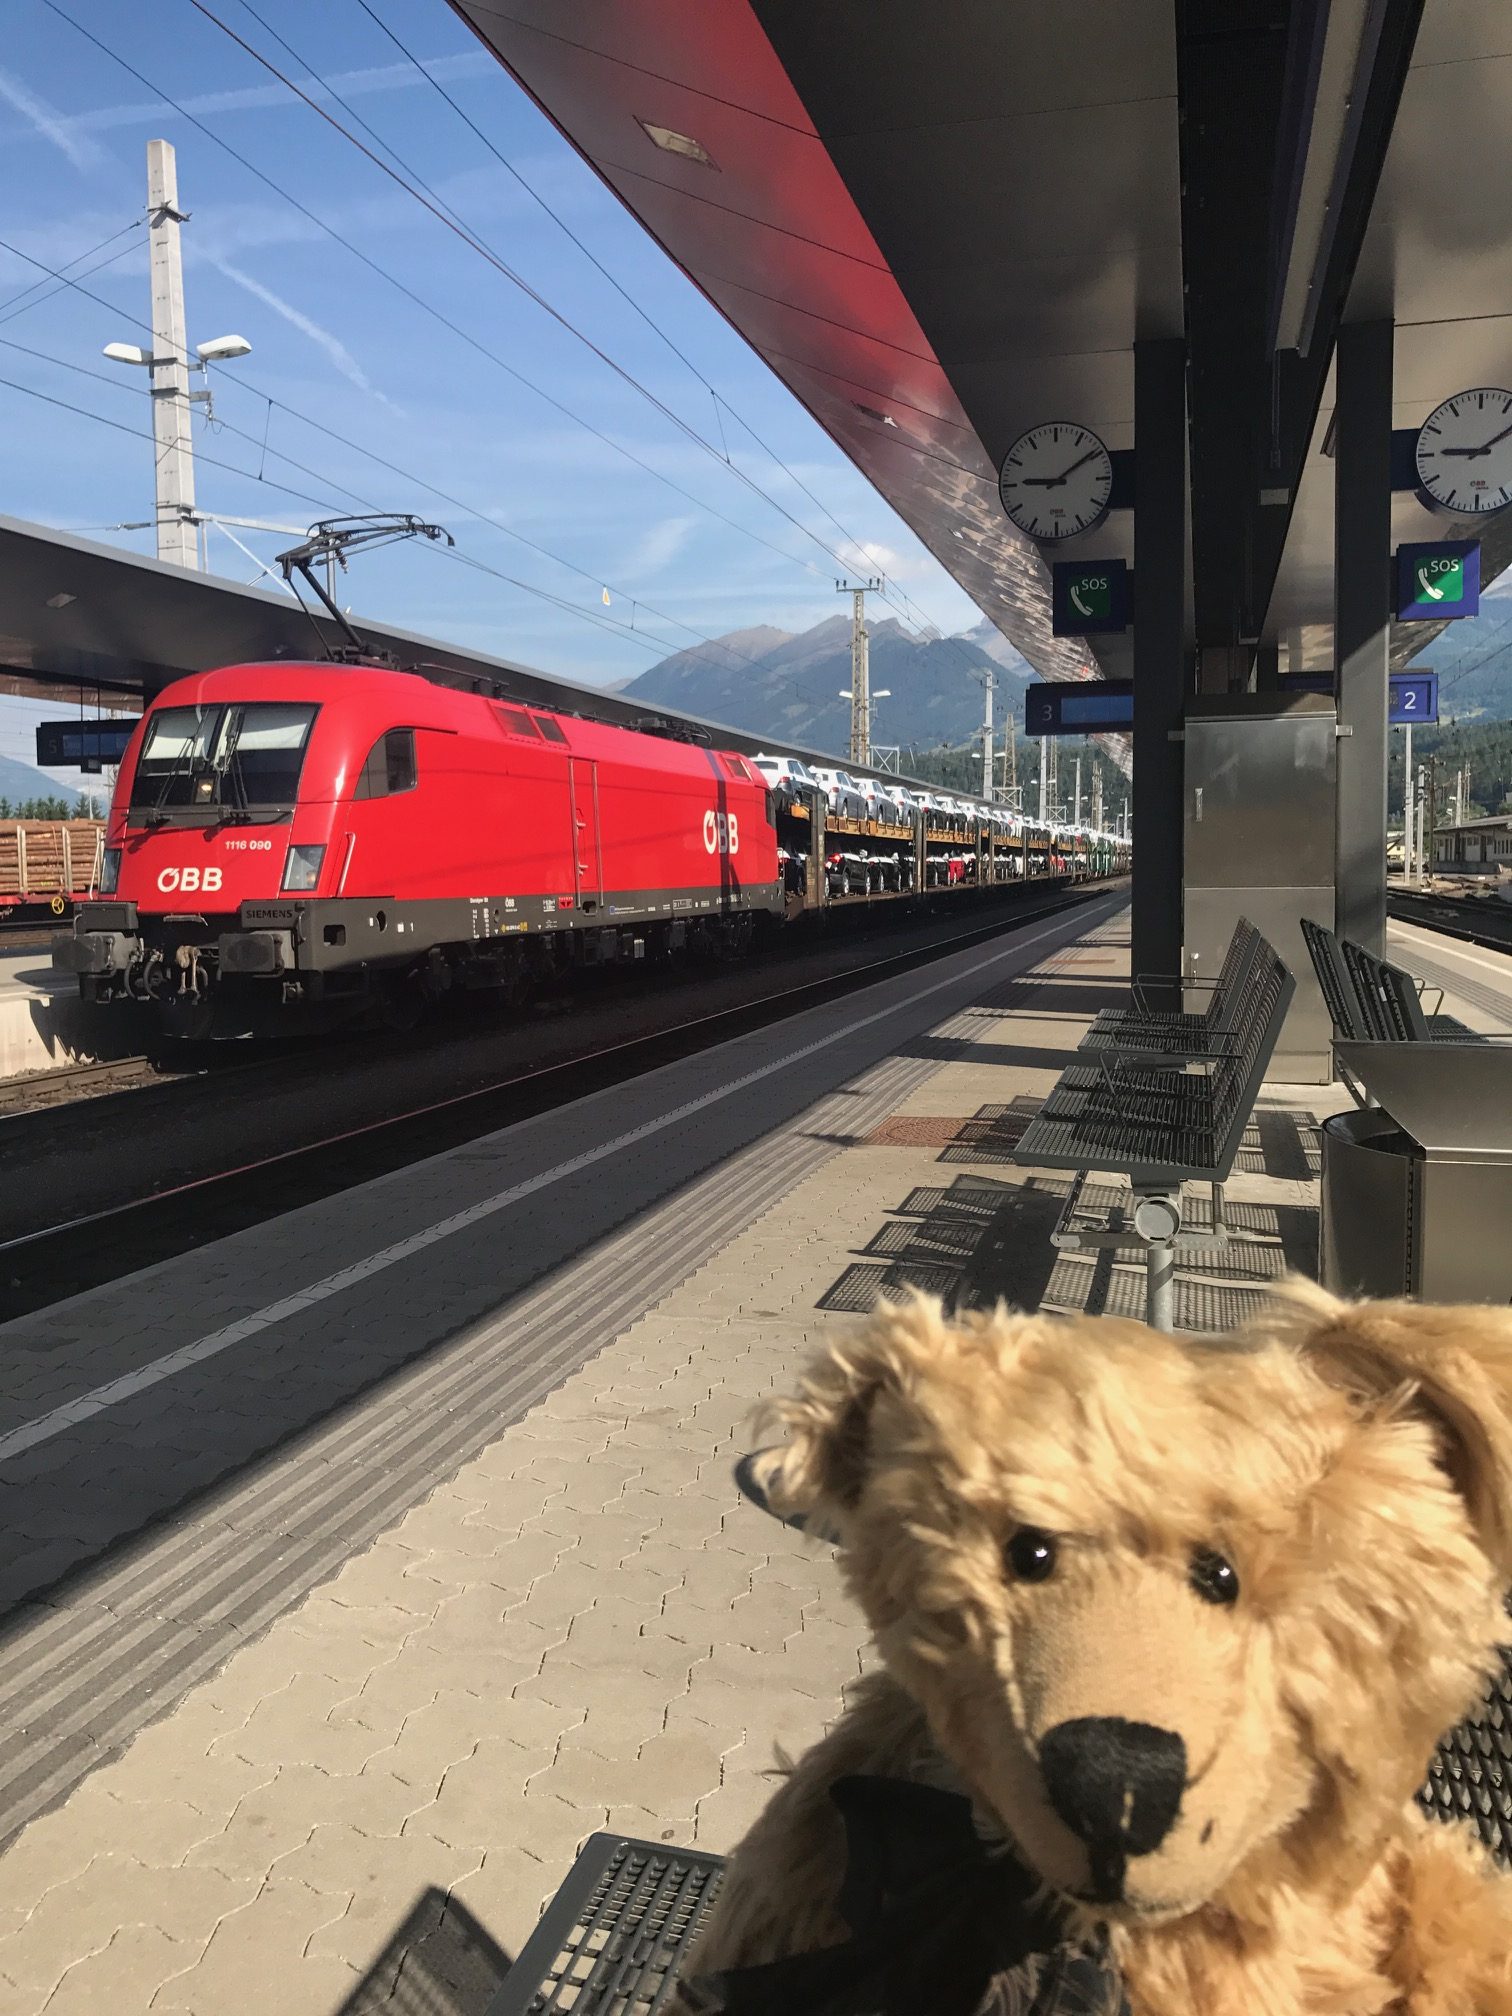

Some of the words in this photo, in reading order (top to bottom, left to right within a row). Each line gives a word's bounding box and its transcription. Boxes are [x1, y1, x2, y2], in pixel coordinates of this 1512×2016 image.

[1430, 558, 1459, 573] SOS
[1081, 578, 1107, 591] SOS
[1404, 691, 1417, 710] 2
[1041, 704, 1053, 721] 3
[703, 809, 739, 854] ÖBB
[225, 840, 247, 850] 1116
[249, 840, 272, 850] 090
[157, 867, 223, 893] ÖBB
[245, 909, 293, 919] SIEMENS
